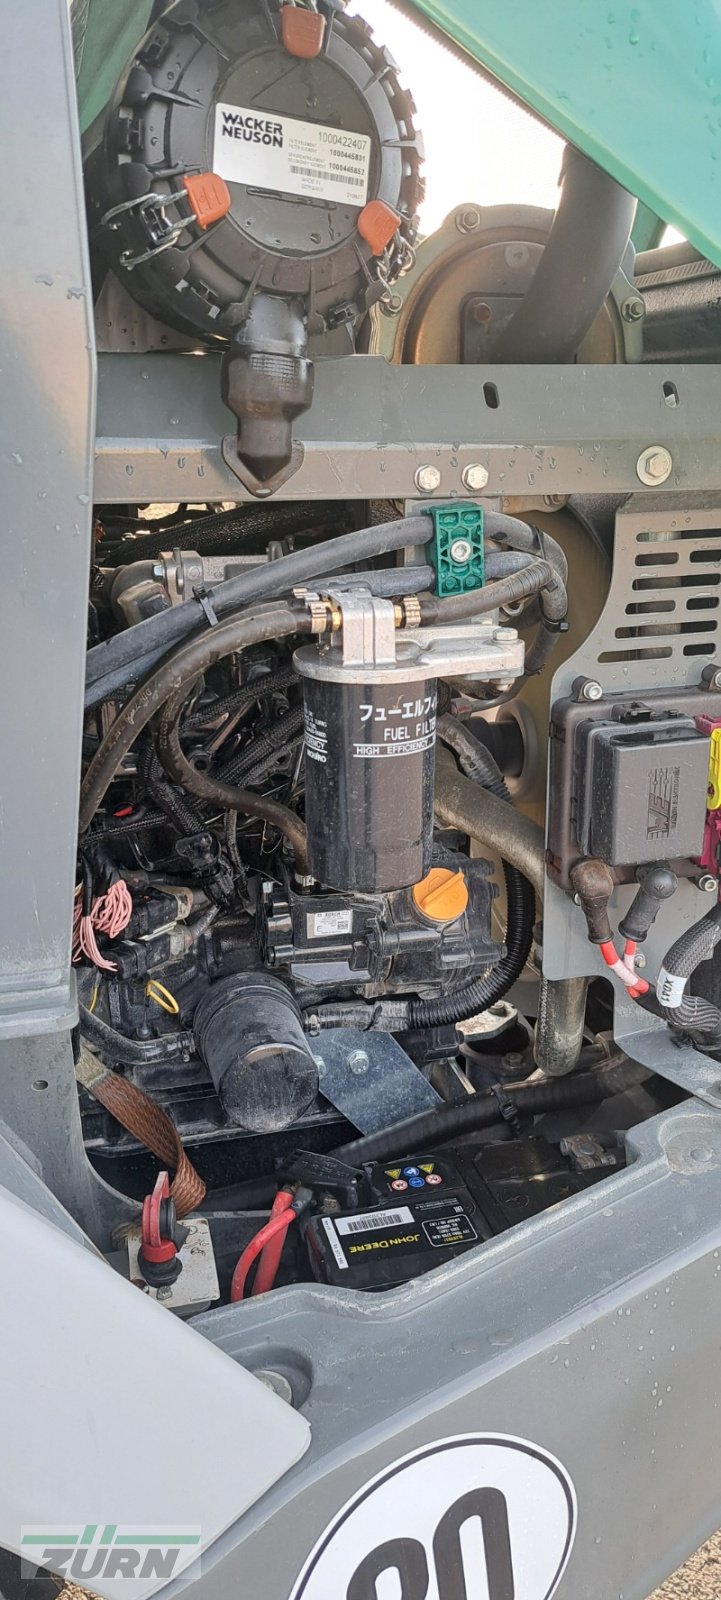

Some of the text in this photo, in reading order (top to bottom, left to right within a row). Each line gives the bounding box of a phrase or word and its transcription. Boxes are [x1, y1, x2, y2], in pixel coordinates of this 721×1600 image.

[222, 112, 283, 135] WACKER
[222, 126, 283, 148] NEUSON
[318, 132, 367, 150] 1000422407
[384, 726, 411, 741] FUEL
[356, 739, 428, 755] HIGH EFFICIENCY
[349, 1233, 421, 1253] JOHN DEERE
